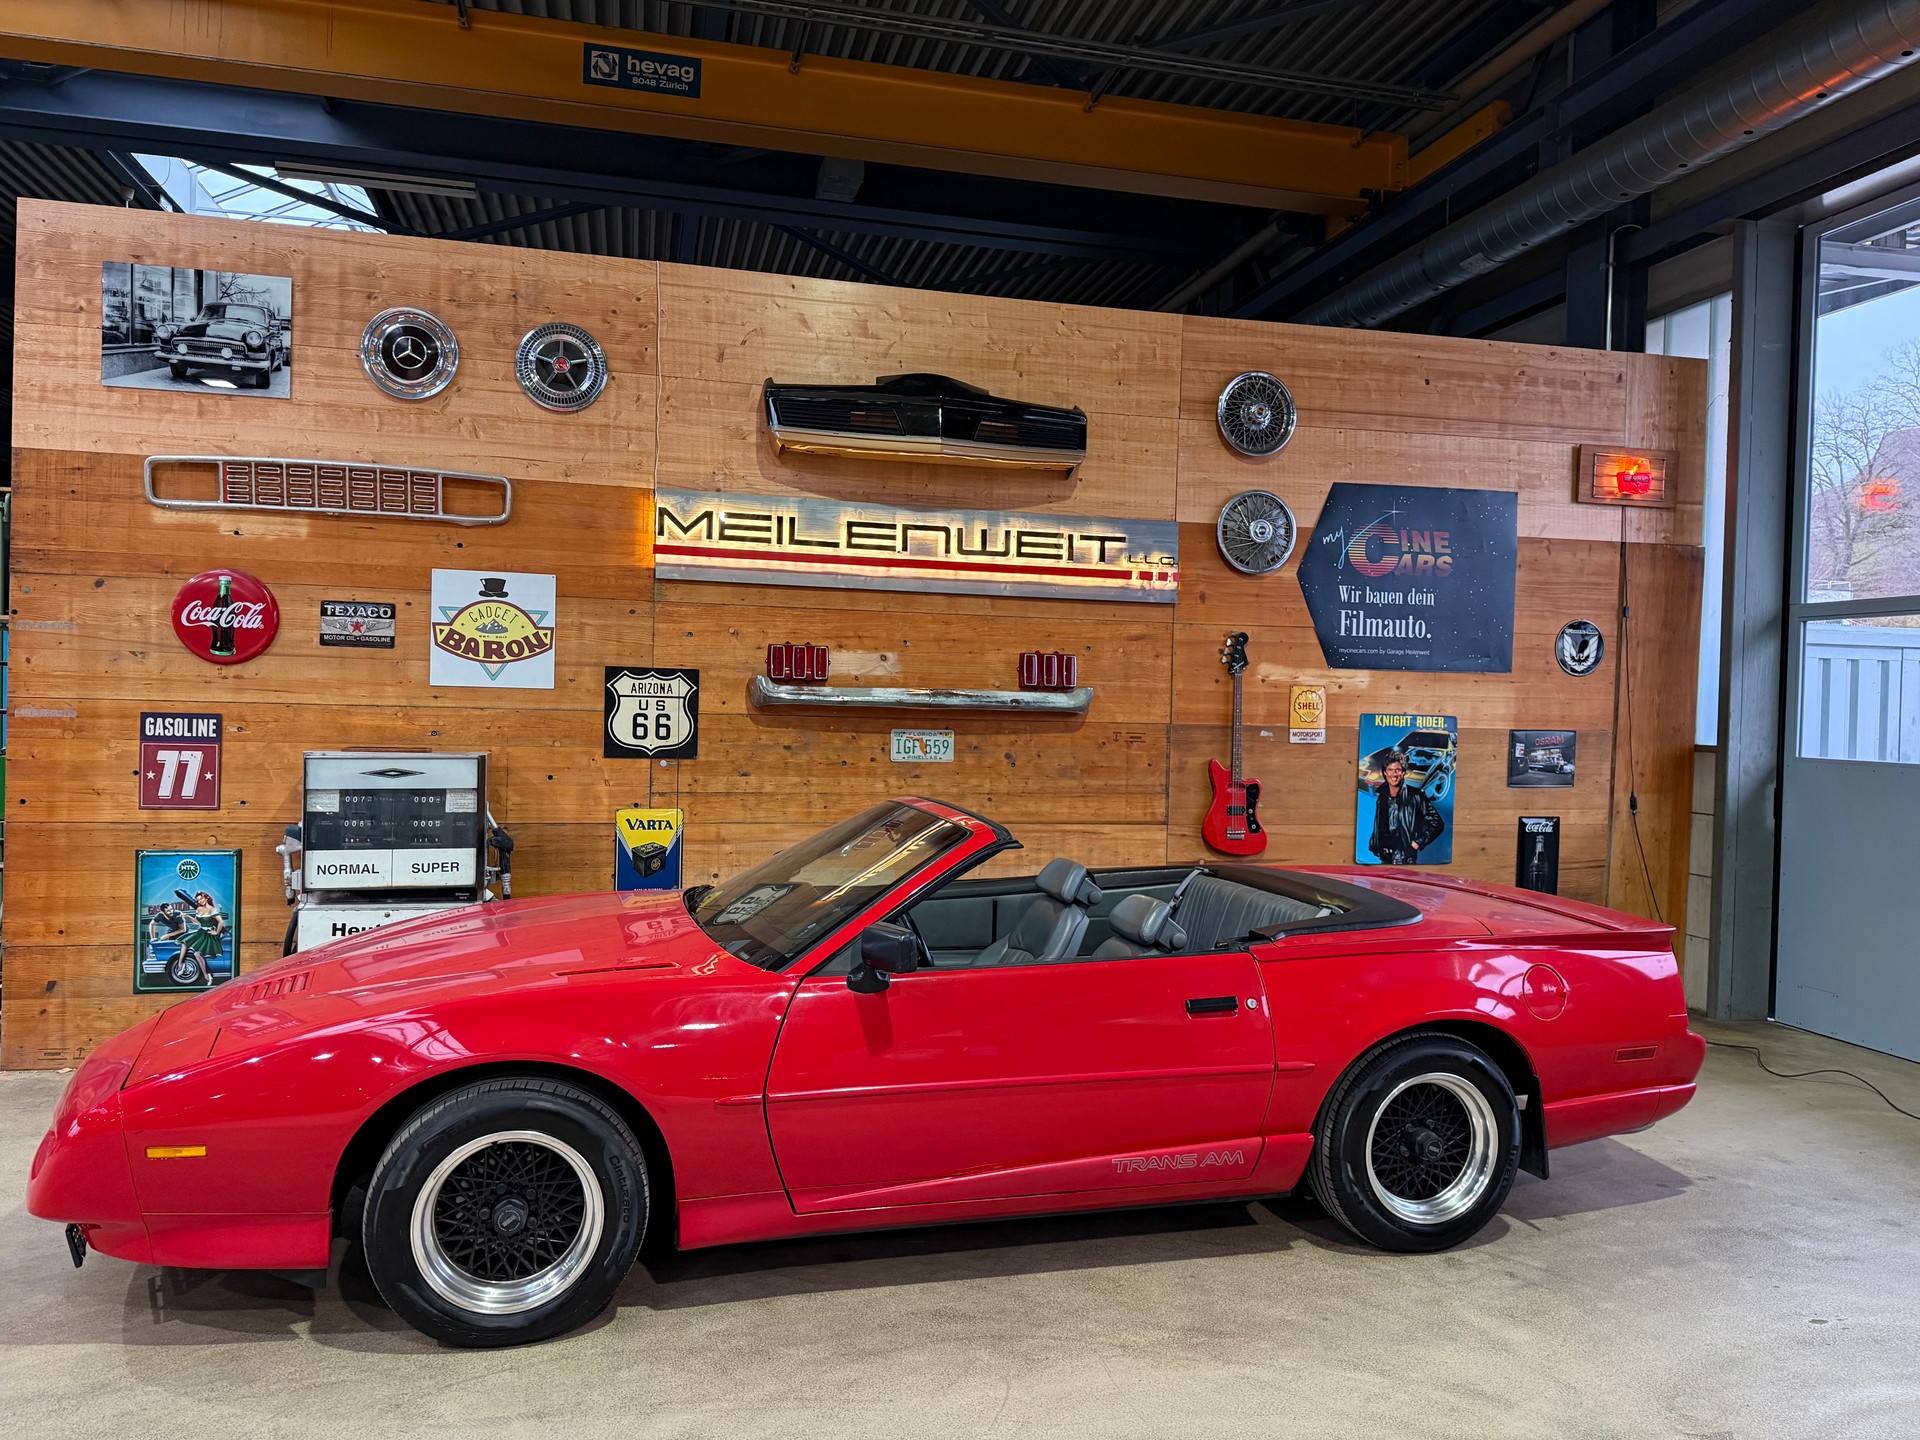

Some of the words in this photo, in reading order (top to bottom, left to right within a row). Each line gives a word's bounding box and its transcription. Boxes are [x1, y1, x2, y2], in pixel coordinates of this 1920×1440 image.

[627, 55, 694, 82] hevag
[632, 76, 656, 87] 8048
[659, 80, 689, 91] Zürich
[657, 506, 1127, 563] MEILENWEIT
[1338, 585, 1362, 603] Wir
[1366, 586, 1403, 605] bauen
[1407, 588, 1435, 606] dein
[181, 600, 266, 629] Coca-Cola
[324, 604, 392, 618] TEXACO
[468, 605, 519, 624] GADGET
[1338, 610, 1432, 639] Filmauto.
[440, 627, 549, 659] BARON
[1386, 648, 1405, 656] Garage
[631, 682, 673, 694] ARIZONA
[1297, 701, 1320, 710] SHELL
[145, 717, 217, 737] GASOLINE
[632, 712, 671, 740] 66
[1375, 714, 1412, 728] KNIGHT
[1535, 734, 1565, 746] OSRAM
[156, 750, 204, 799] 77
[625, 818, 674, 831] VARTA
[316, 863, 379, 875] NORMAL
[411, 861, 460, 874] SUPER
[1111, 1153, 1198, 1173] TRANS
[1199, 1149, 1244, 1167] AM
